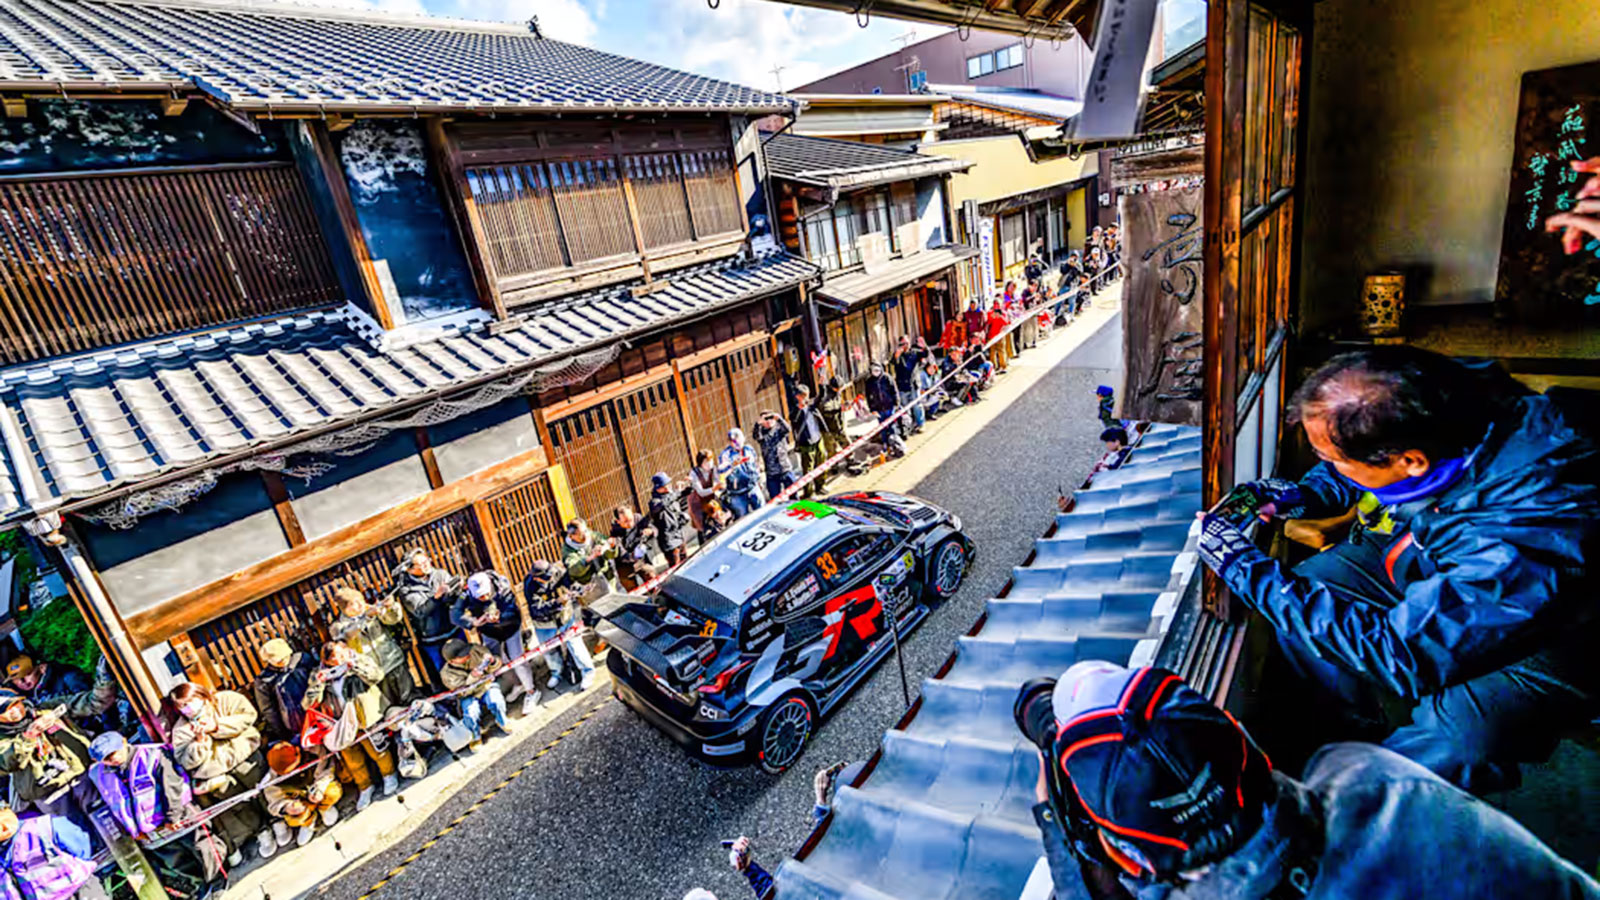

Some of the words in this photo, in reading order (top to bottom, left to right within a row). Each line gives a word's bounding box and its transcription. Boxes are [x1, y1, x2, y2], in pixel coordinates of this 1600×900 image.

[741, 531, 776, 552] 33
[816, 551, 838, 580] 33
[700, 705, 718, 720] CCI
